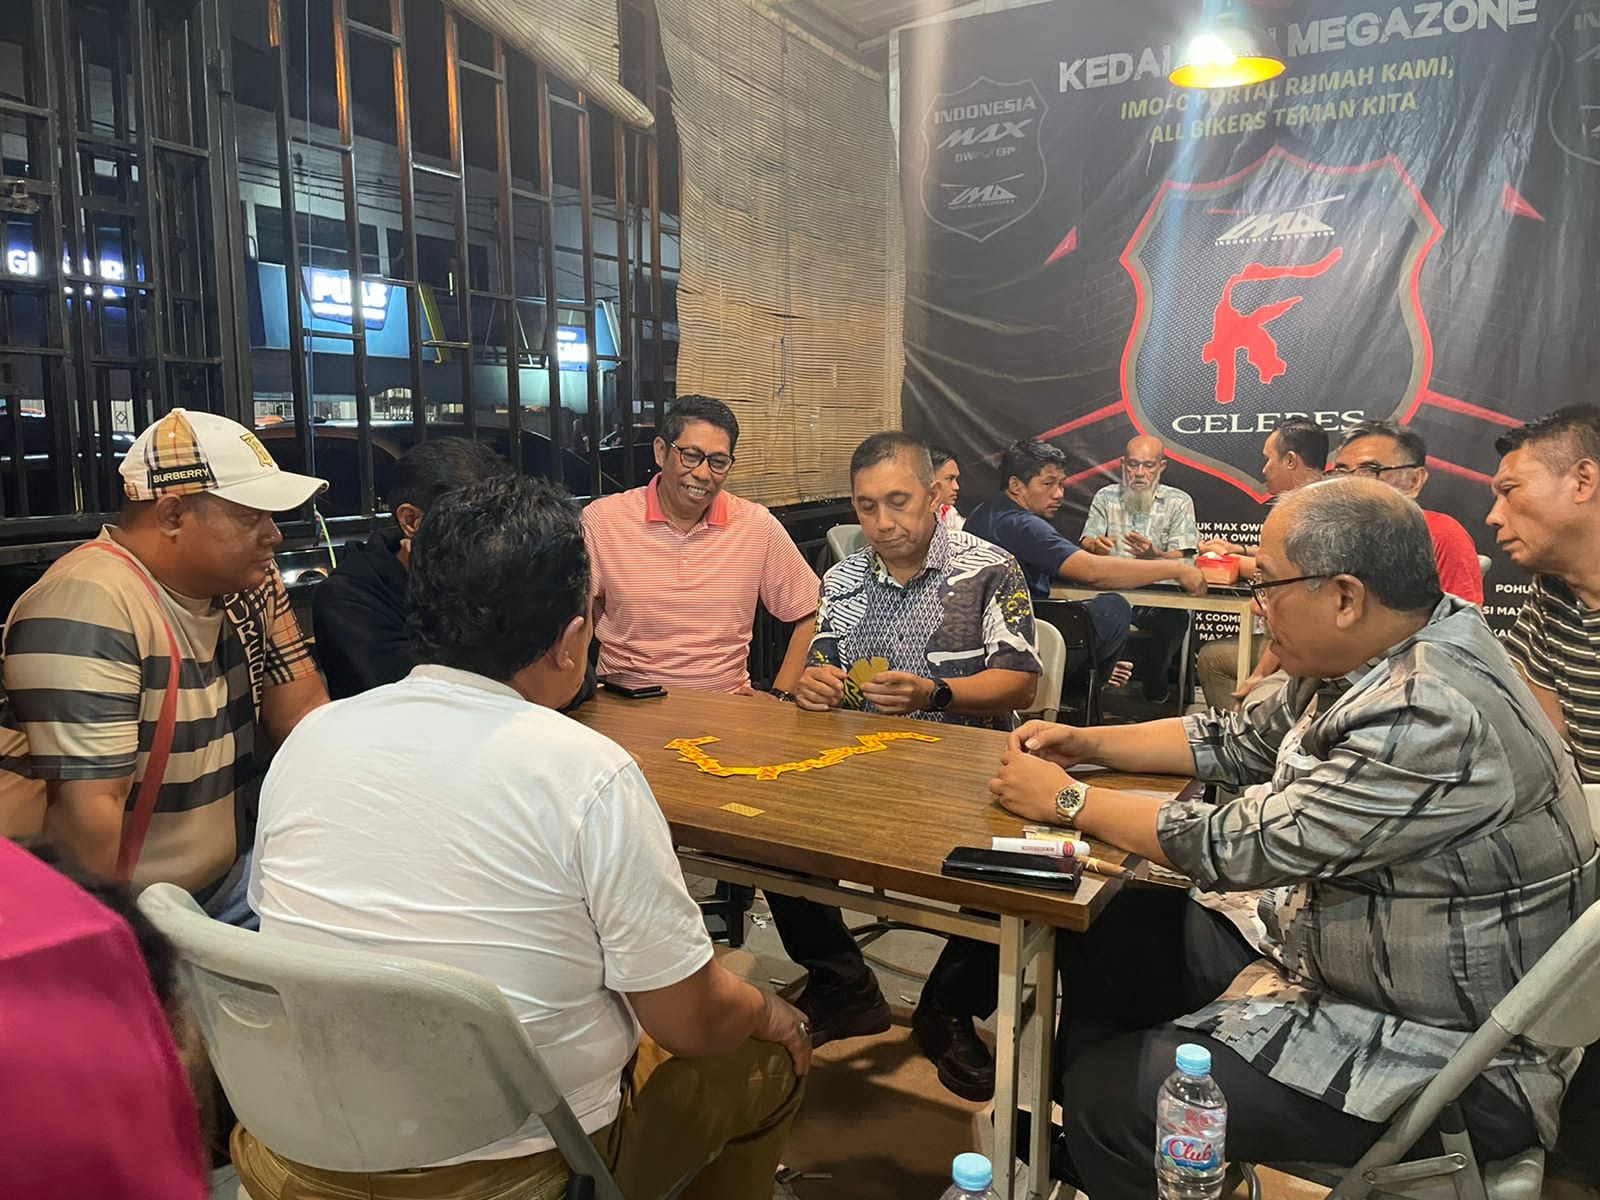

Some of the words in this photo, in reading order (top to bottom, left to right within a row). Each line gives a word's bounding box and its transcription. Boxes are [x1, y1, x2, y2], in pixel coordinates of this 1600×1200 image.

[1287, 0, 1537, 57] MEGAZONE
[1285, 66, 1374, 97] RUMAH
[1381, 55, 1454, 83] KAMI,
[934, 96, 1037, 124] INDONESIA
[1149, 122, 1184, 143] ALL
[1192, 110, 1267, 137] BIKERS
[1274, 97, 1355, 127] TEMAN
[1362, 91, 1417, 116] KITA
[152, 467, 209, 484] BURBERRY
[1214, 522, 1238, 531] MAX
[1168, 1138, 1213, 1161] Club
